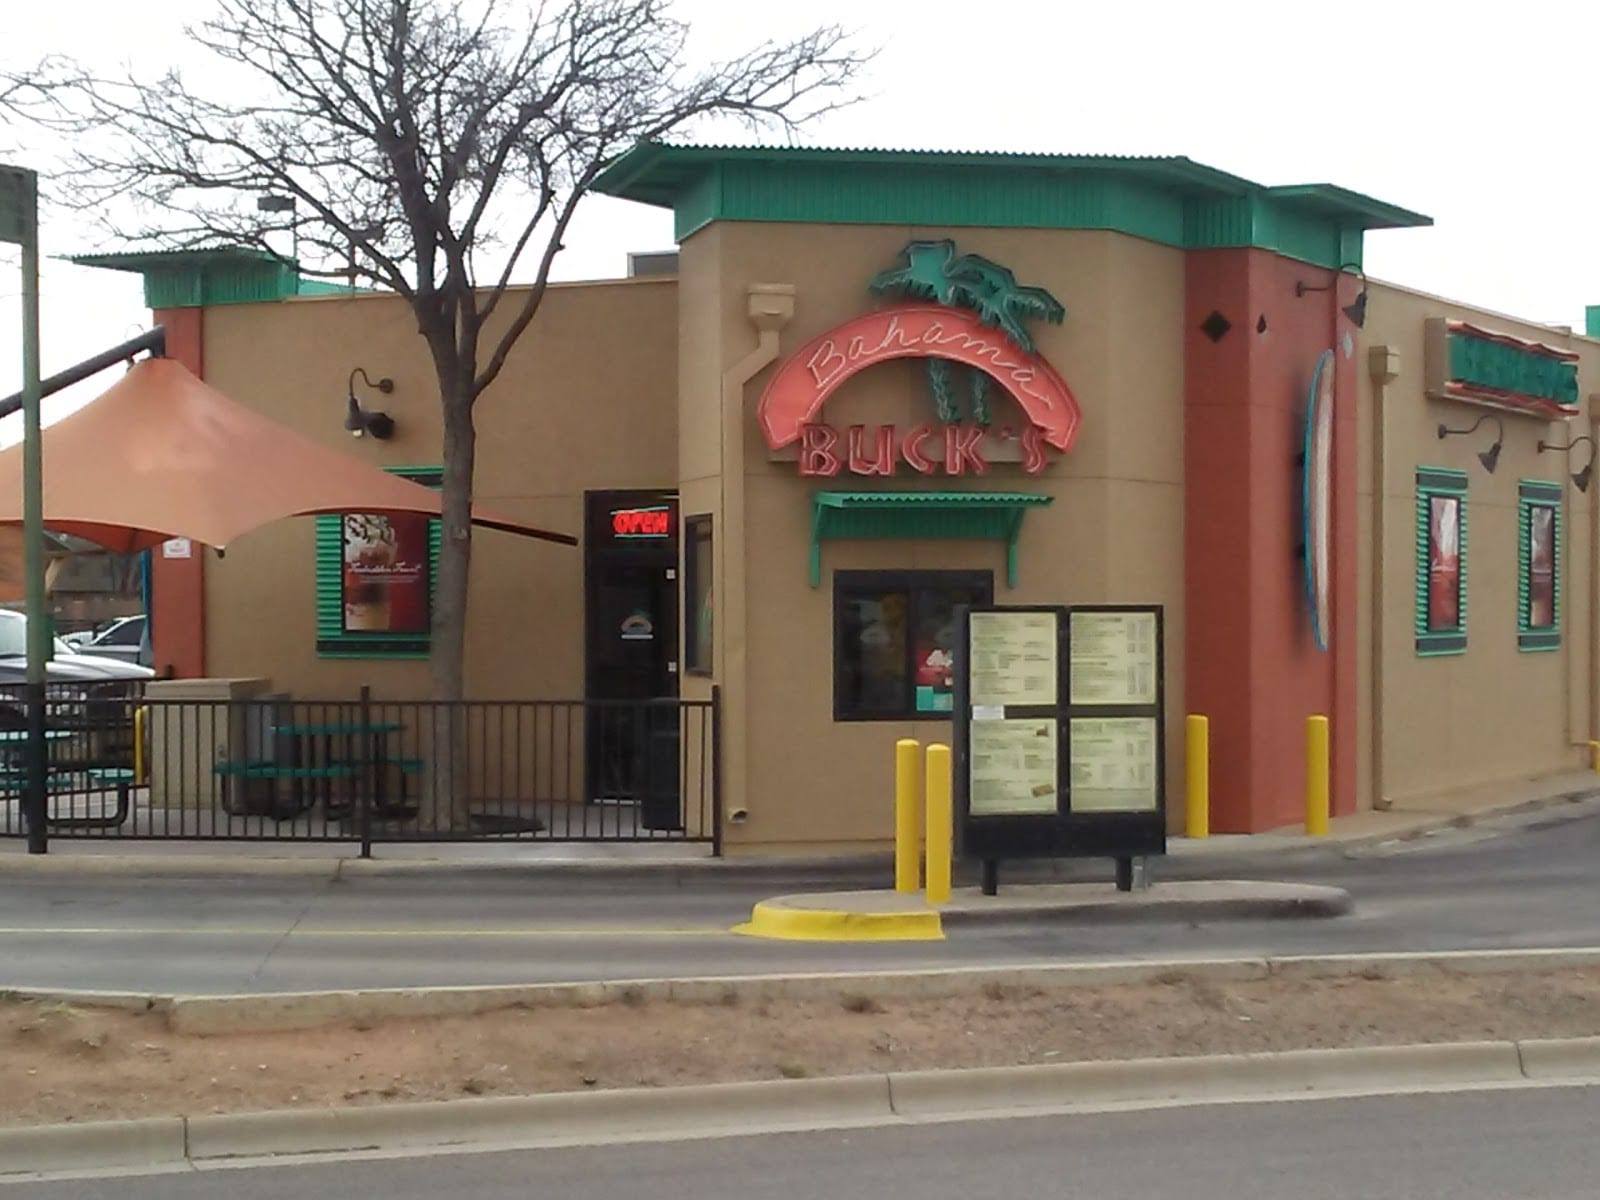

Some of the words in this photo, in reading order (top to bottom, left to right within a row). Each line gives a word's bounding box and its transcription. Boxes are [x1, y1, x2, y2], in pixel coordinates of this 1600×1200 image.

[807, 315, 1054, 411] Bahama
[799, 423, 1054, 476] BUCK'S
[612, 510, 669, 534] OPEN
